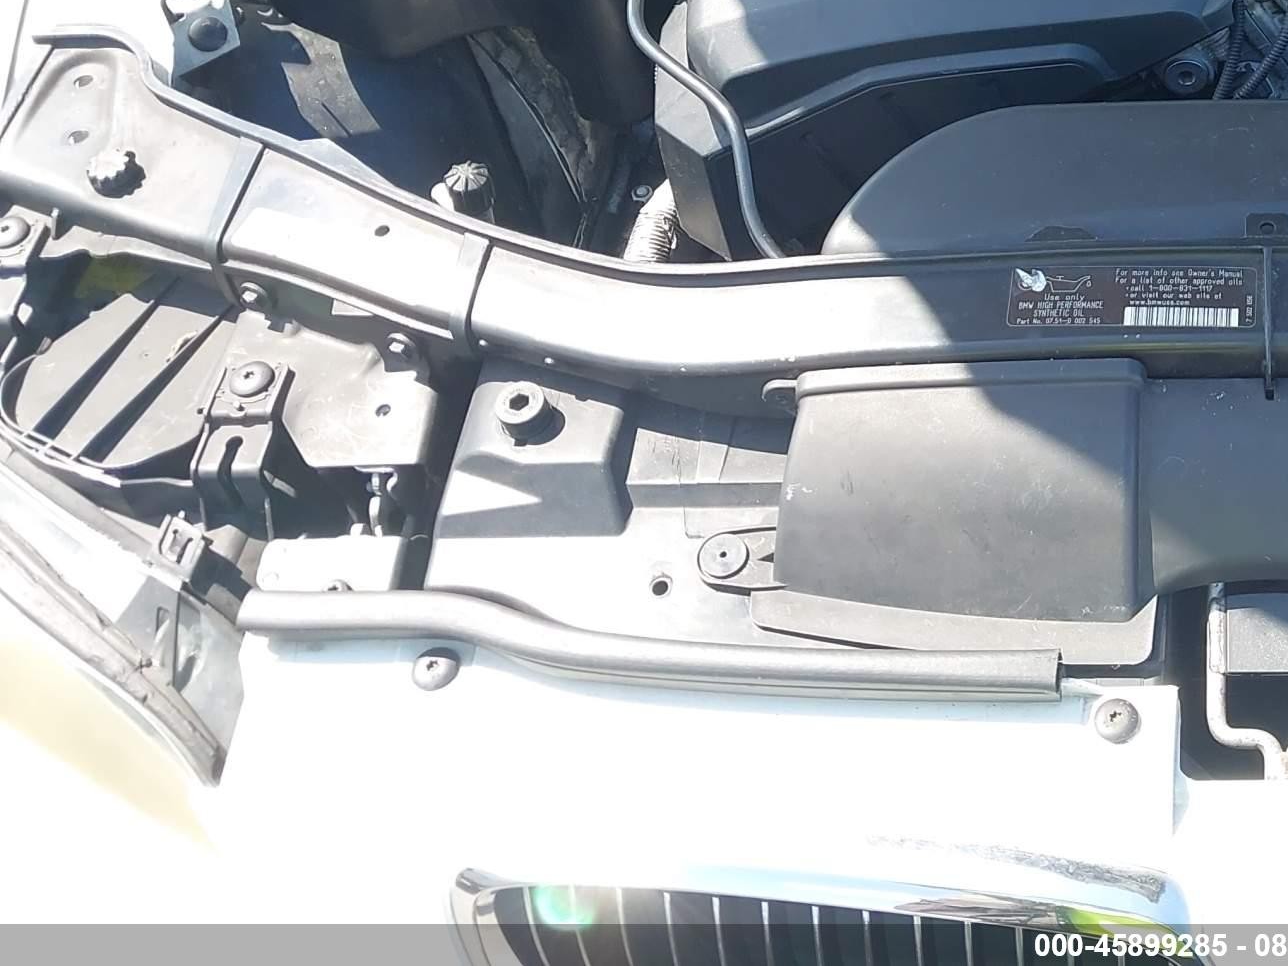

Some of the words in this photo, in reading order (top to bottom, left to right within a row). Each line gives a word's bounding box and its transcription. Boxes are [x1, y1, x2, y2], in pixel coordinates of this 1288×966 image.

[1115, 267, 1128, 276] For
[1153, 267, 1168, 276] info
[1187, 268, 1215, 277] Owner's
[1218, 268, 1243, 278] Manual
[1115, 275, 1128, 284] For
[1140, 275, 1153, 284] list
[1157, 275, 1166, 284] of
[1169, 276, 1188, 284] other
[1192, 277, 1225, 286] approved
[1044, 293, 1060, 301] Use
[1065, 293, 1086, 303] only
[1142, 291, 1159, 299] visit
[1196, 291, 1210, 299] site
[1214, 292, 1222, 300] at
[1018, 301, 1035, 310] BMW
[1037, 301, 1054, 309] HIGH
[1056, 300, 1104, 309] PERFORMANCE
[1033, 309, 1070, 317] SYNTHETIC
[1073, 309, 1085, 317] OIL
